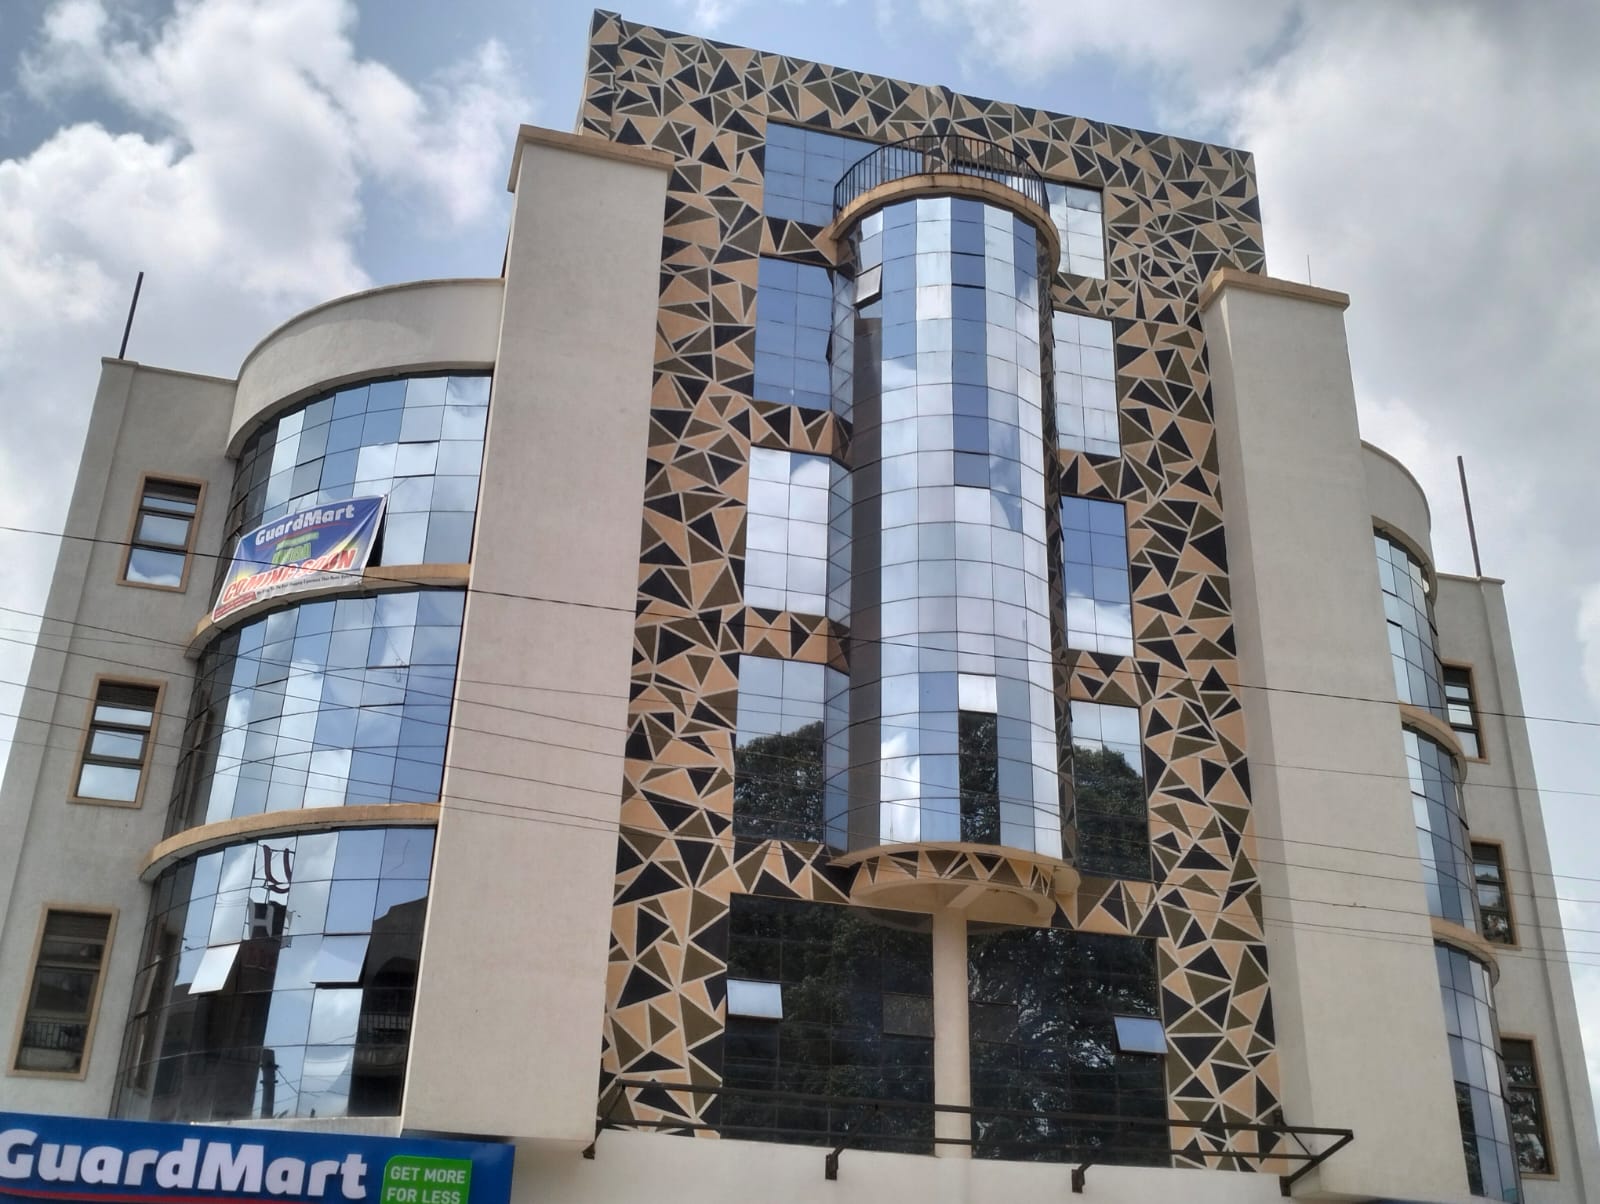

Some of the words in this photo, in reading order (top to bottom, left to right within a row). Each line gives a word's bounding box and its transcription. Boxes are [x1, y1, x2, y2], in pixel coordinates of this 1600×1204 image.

[255, 504, 355, 546] GuardMart
[300, 549, 357, 576] SOON
[0, 1129, 368, 1199] GuardMart
[390, 1166, 420, 1181] GET
[424, 1168, 466, 1184] MORE
[386, 1187, 418, 1203] FOR
[422, 1189, 461, 1204] LESS
